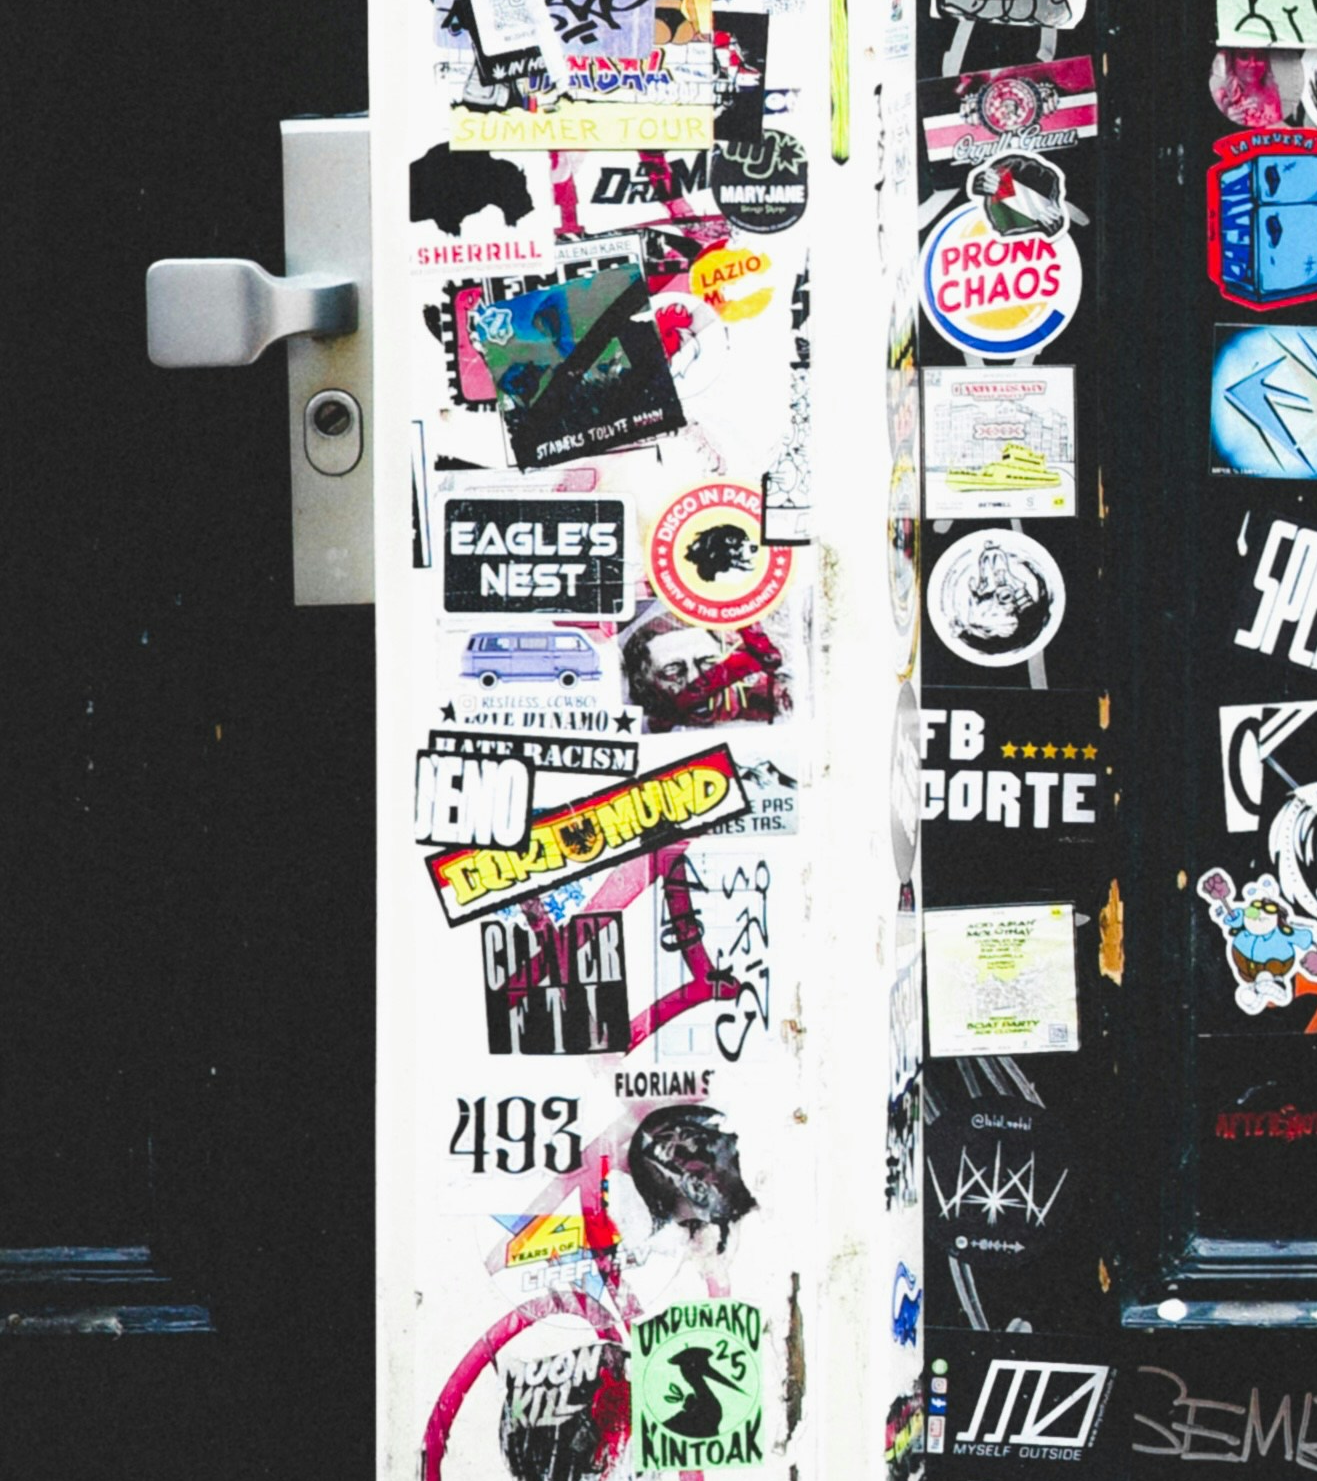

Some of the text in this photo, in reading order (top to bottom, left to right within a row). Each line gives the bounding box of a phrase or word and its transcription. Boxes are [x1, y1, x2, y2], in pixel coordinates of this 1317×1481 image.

[457, 117, 705, 142] SUMMER TOUR
[416, 241, 543, 266] SHERRILL
[936, 263, 1062, 315] CHAOS
[450, 522, 618, 556] EAGLE'S
[480, 563, 586, 597] NEST
[614, 1071, 697, 1097] FLORIAN
[450, 1096, 583, 1174] 493
[953, 1443, 1082, 1461] MYSELF OUTSIDE
